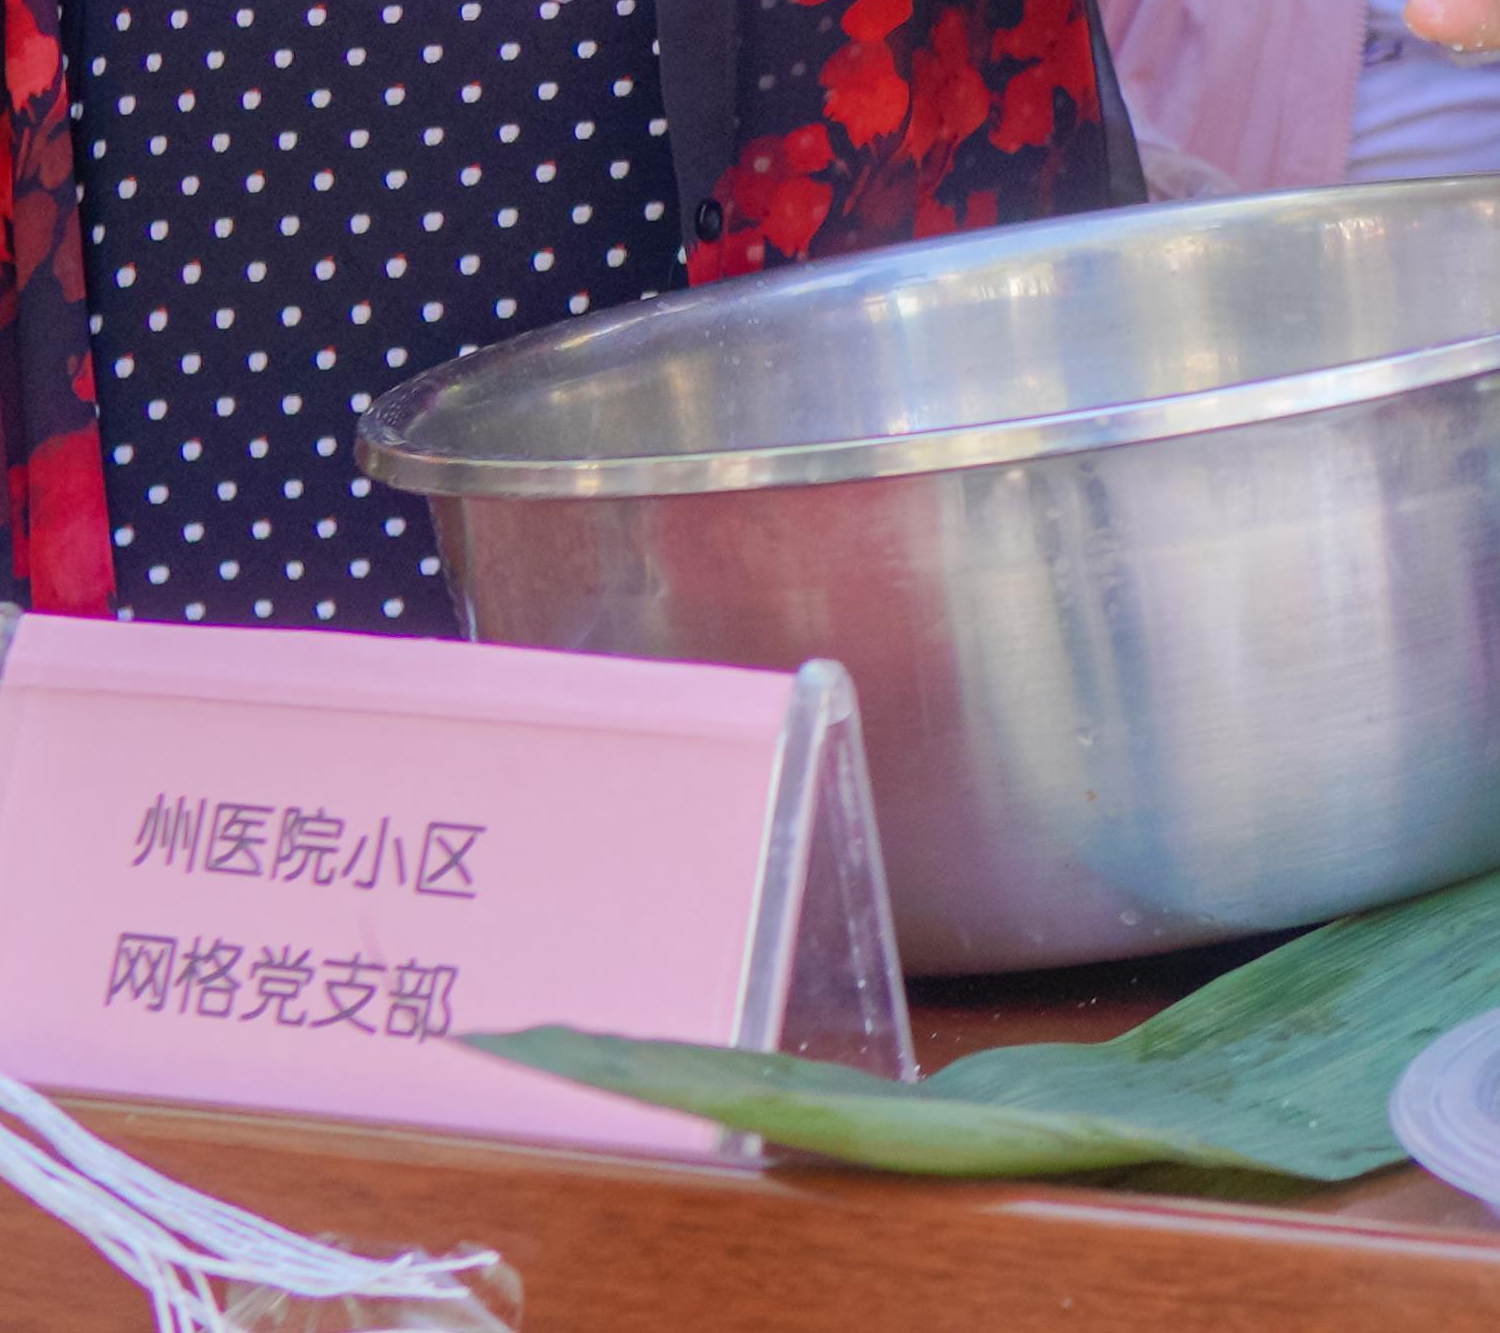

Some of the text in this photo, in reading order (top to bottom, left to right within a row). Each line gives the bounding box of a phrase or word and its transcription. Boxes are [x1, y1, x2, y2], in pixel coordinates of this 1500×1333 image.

[131, 792, 488, 900] 州医院小区
[103, 931, 460, 1043] 网格党支部
